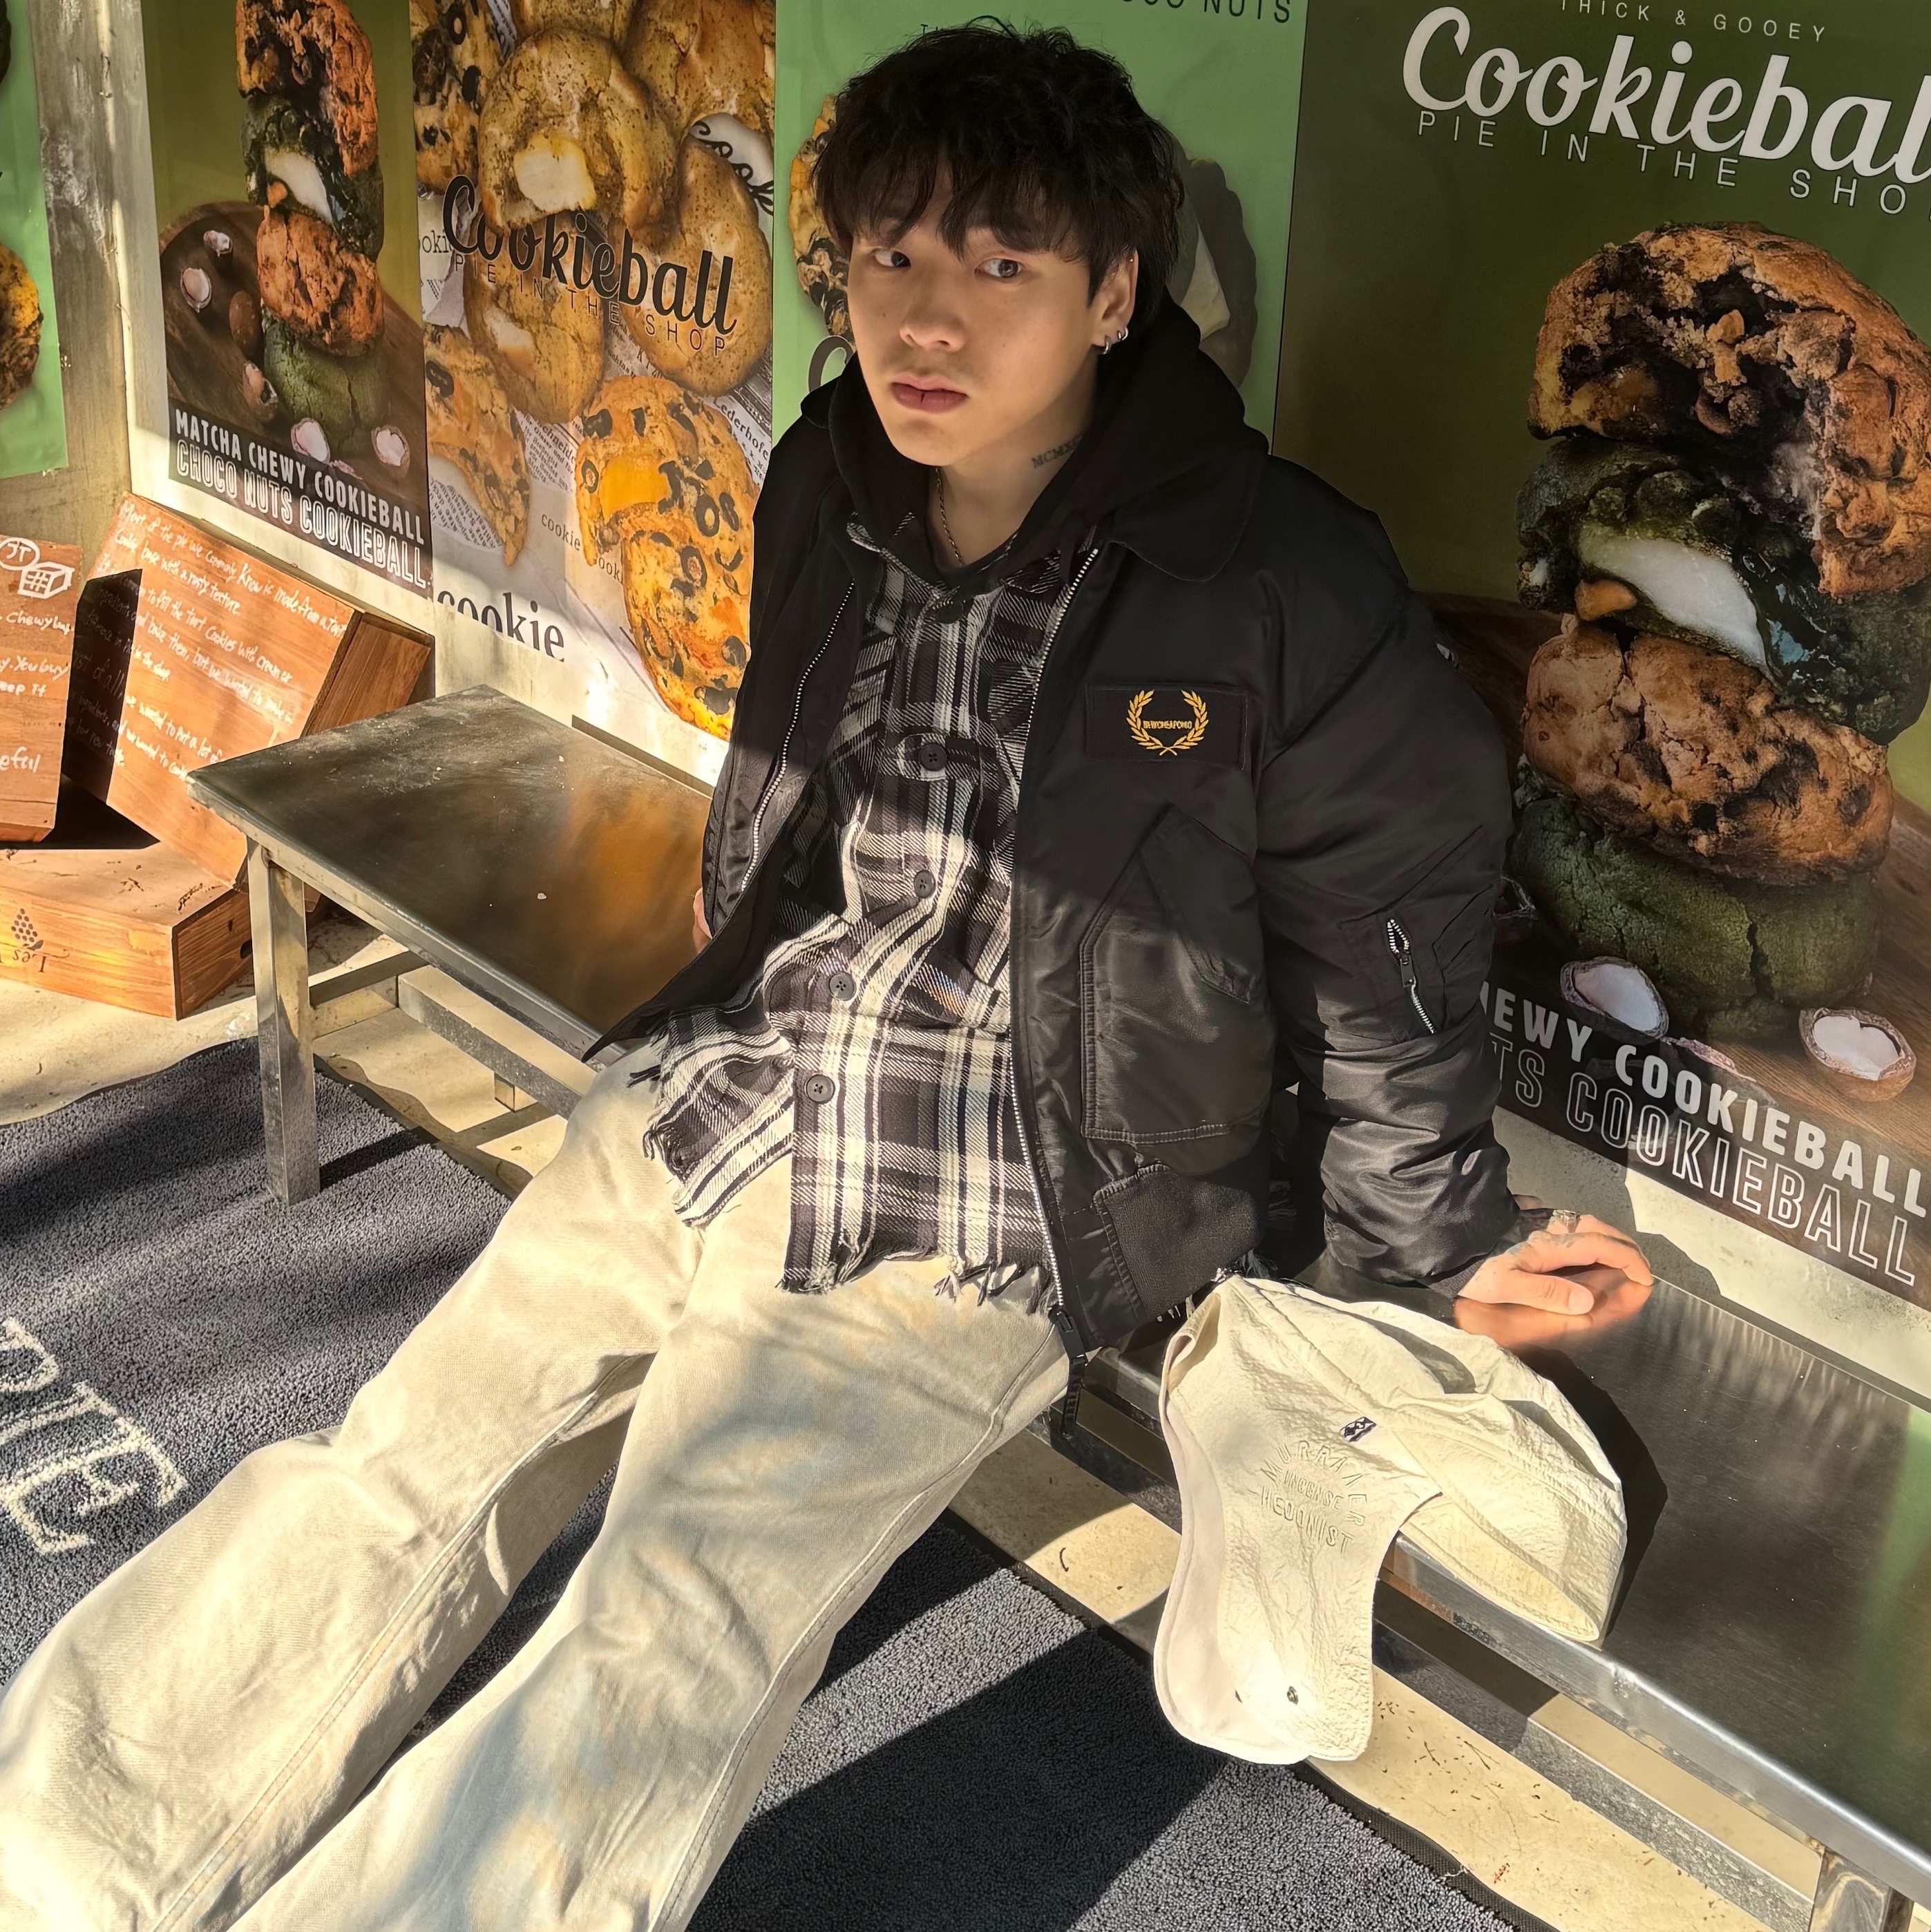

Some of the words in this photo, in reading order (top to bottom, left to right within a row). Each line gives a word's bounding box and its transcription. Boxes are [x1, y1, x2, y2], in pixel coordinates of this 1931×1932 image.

[1675, 10, 1686, 26] &
[1713, 14, 1825, 42] GOOEY
[1402, 6, 1931, 184] Cookiebal
[1418, 110, 1496, 147] PIE
[1541, 129, 1590, 162] IN
[1636, 144, 1740, 187] THE
[1789, 169, 1931, 220] SHO
[443, 174, 736, 335] Cookieball
[455, 253, 496, 284] PIE
[519, 273, 543, 300] IN
[567, 288, 620, 325] THE
[645, 314, 725, 358] SHOP
[175, 409, 242, 461] MATCHA
[248, 442, 307, 489] CHEWY
[314, 471, 425, 545] COOKIEBALL
[176, 439, 238, 499] CHOCO
[243, 469, 293, 525] NUTS
[299, 495, 427, 589] COOKIEBALL
[541, 513, 581, 551] cookie
[598, 557, 623, 586] ook
[0, 680, 26, 696] eep
[0, 745, 41, 774] eful
[1479, 981, 1592, 1062] EWY
[1615, 1044, 1926, 1218] COOKIEBALL
[1489, 1031, 1545, 1108] TS
[1567, 1072, 1915, 1287] COOKIEBALL
[1261, 1484, 1354, 1553] HEDONIST
[1284, 1469, 1345, 1511] INCENSE
